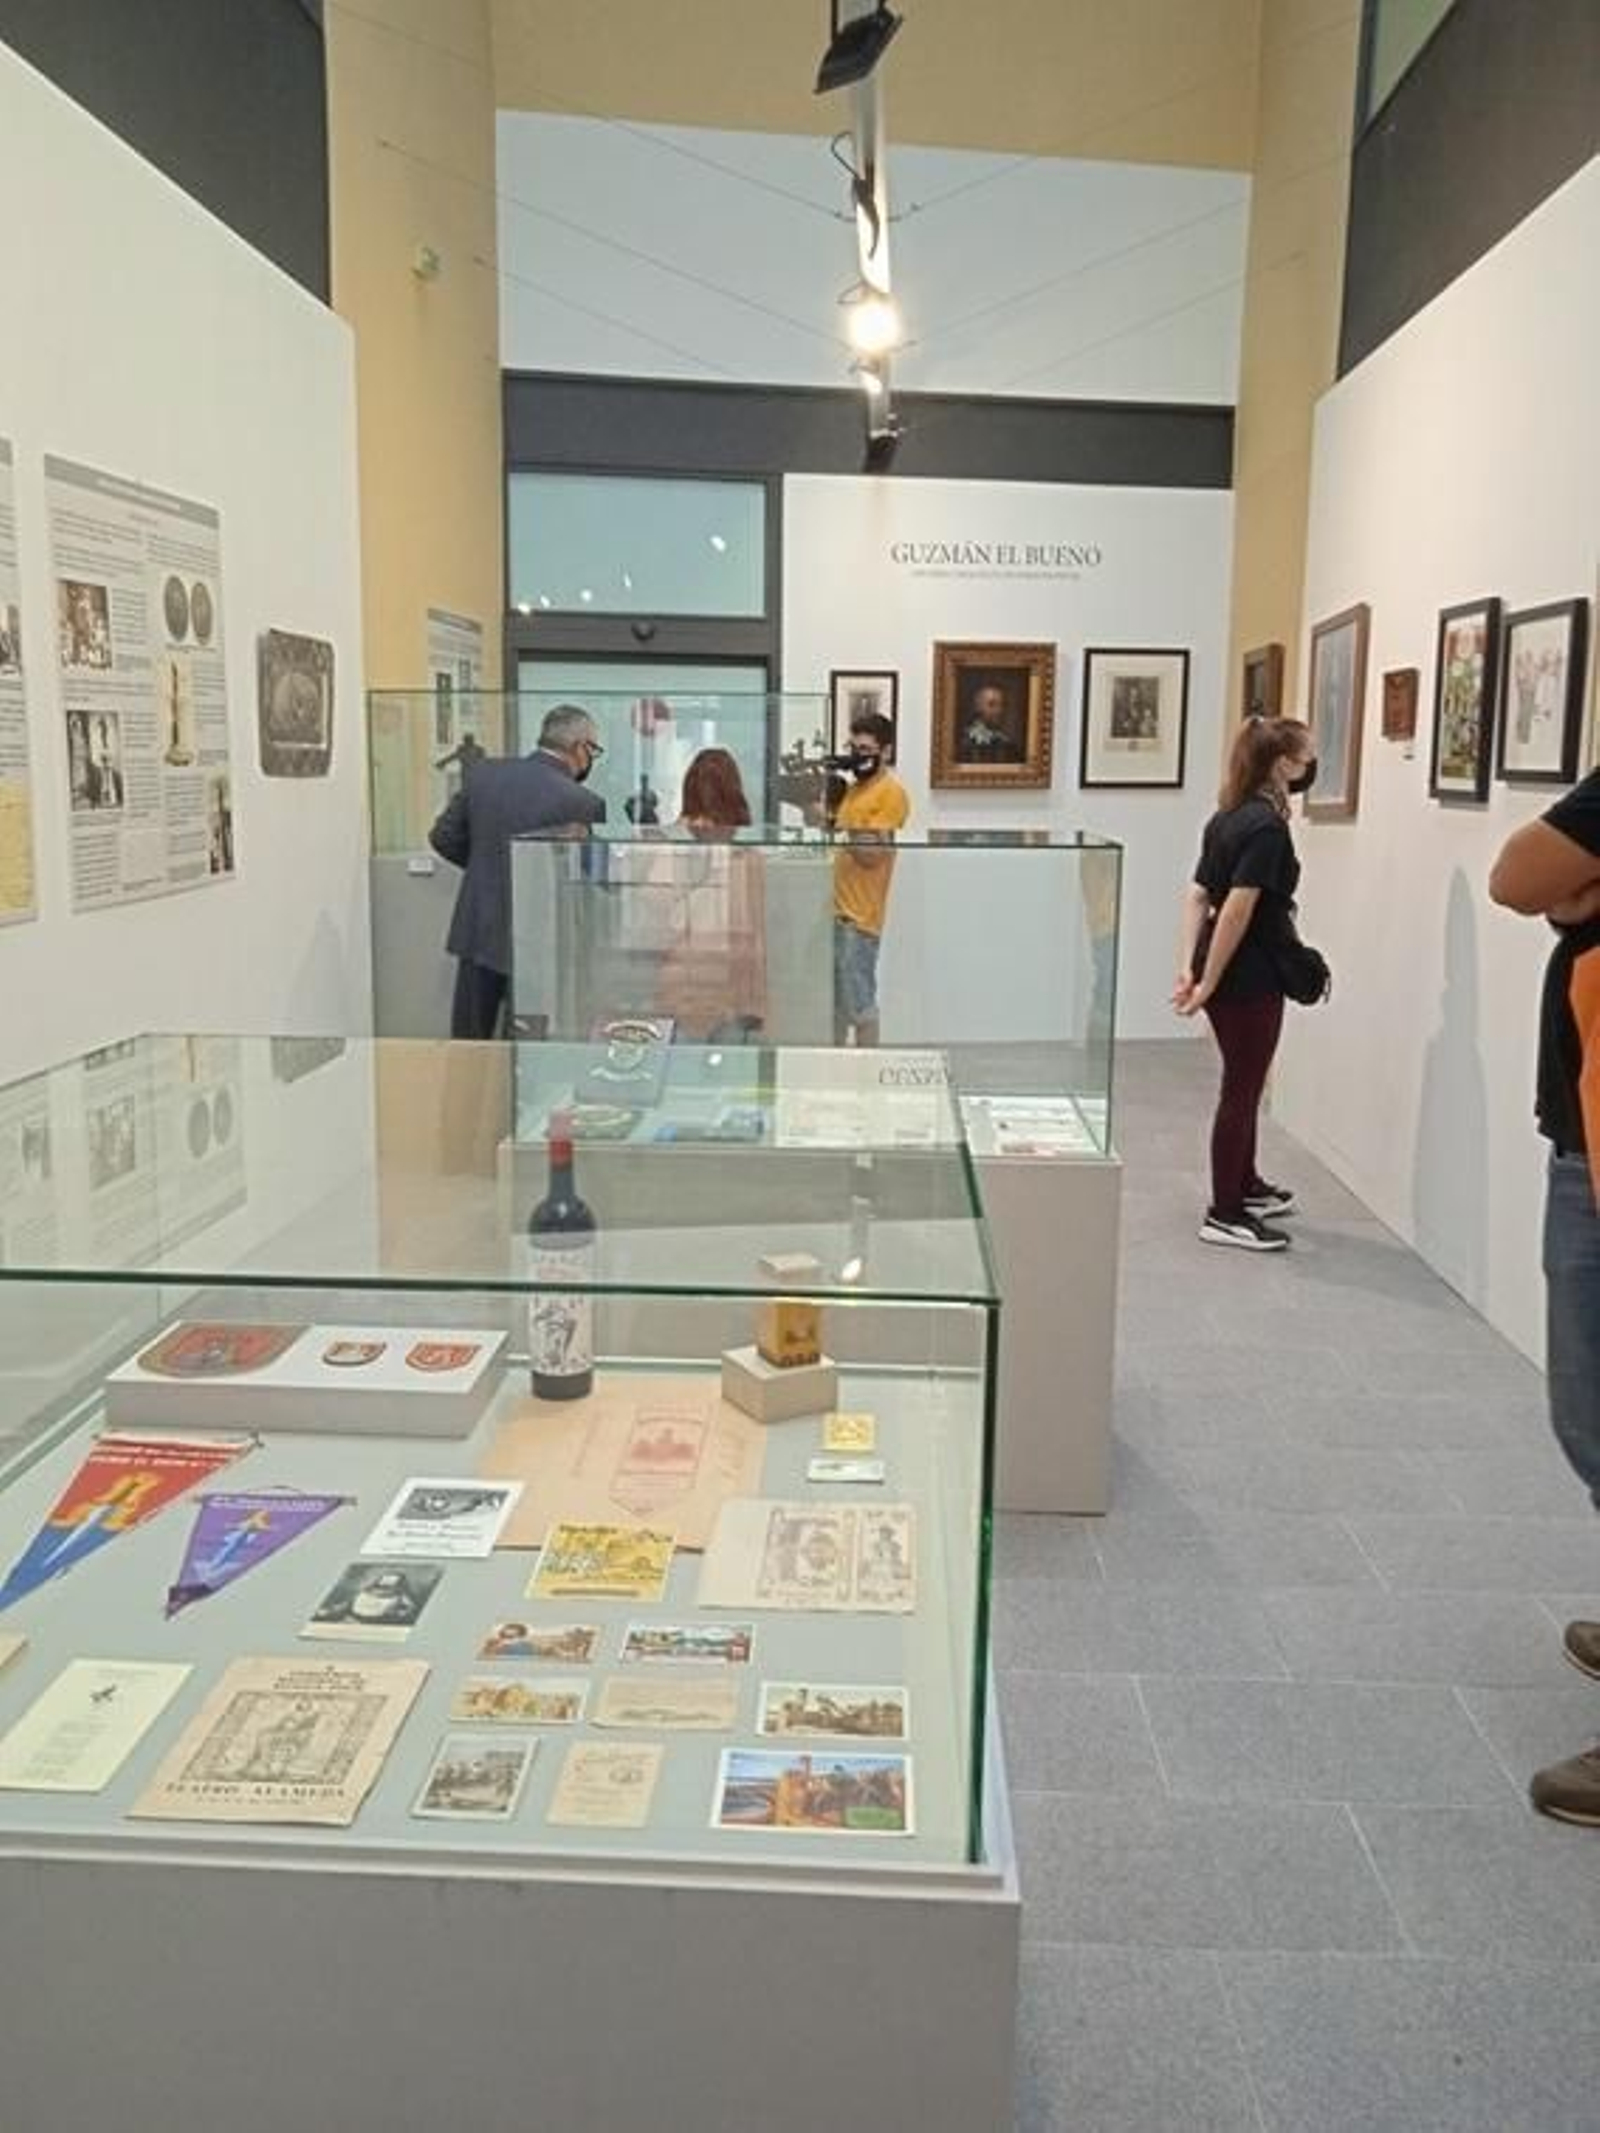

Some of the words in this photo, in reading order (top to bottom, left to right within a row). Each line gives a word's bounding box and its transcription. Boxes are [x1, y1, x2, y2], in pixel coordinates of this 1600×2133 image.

[891, 541, 990, 565] GUZMÁN
[997, 545, 1020, 565] EL
[1026, 545, 1101, 567] BUENO
